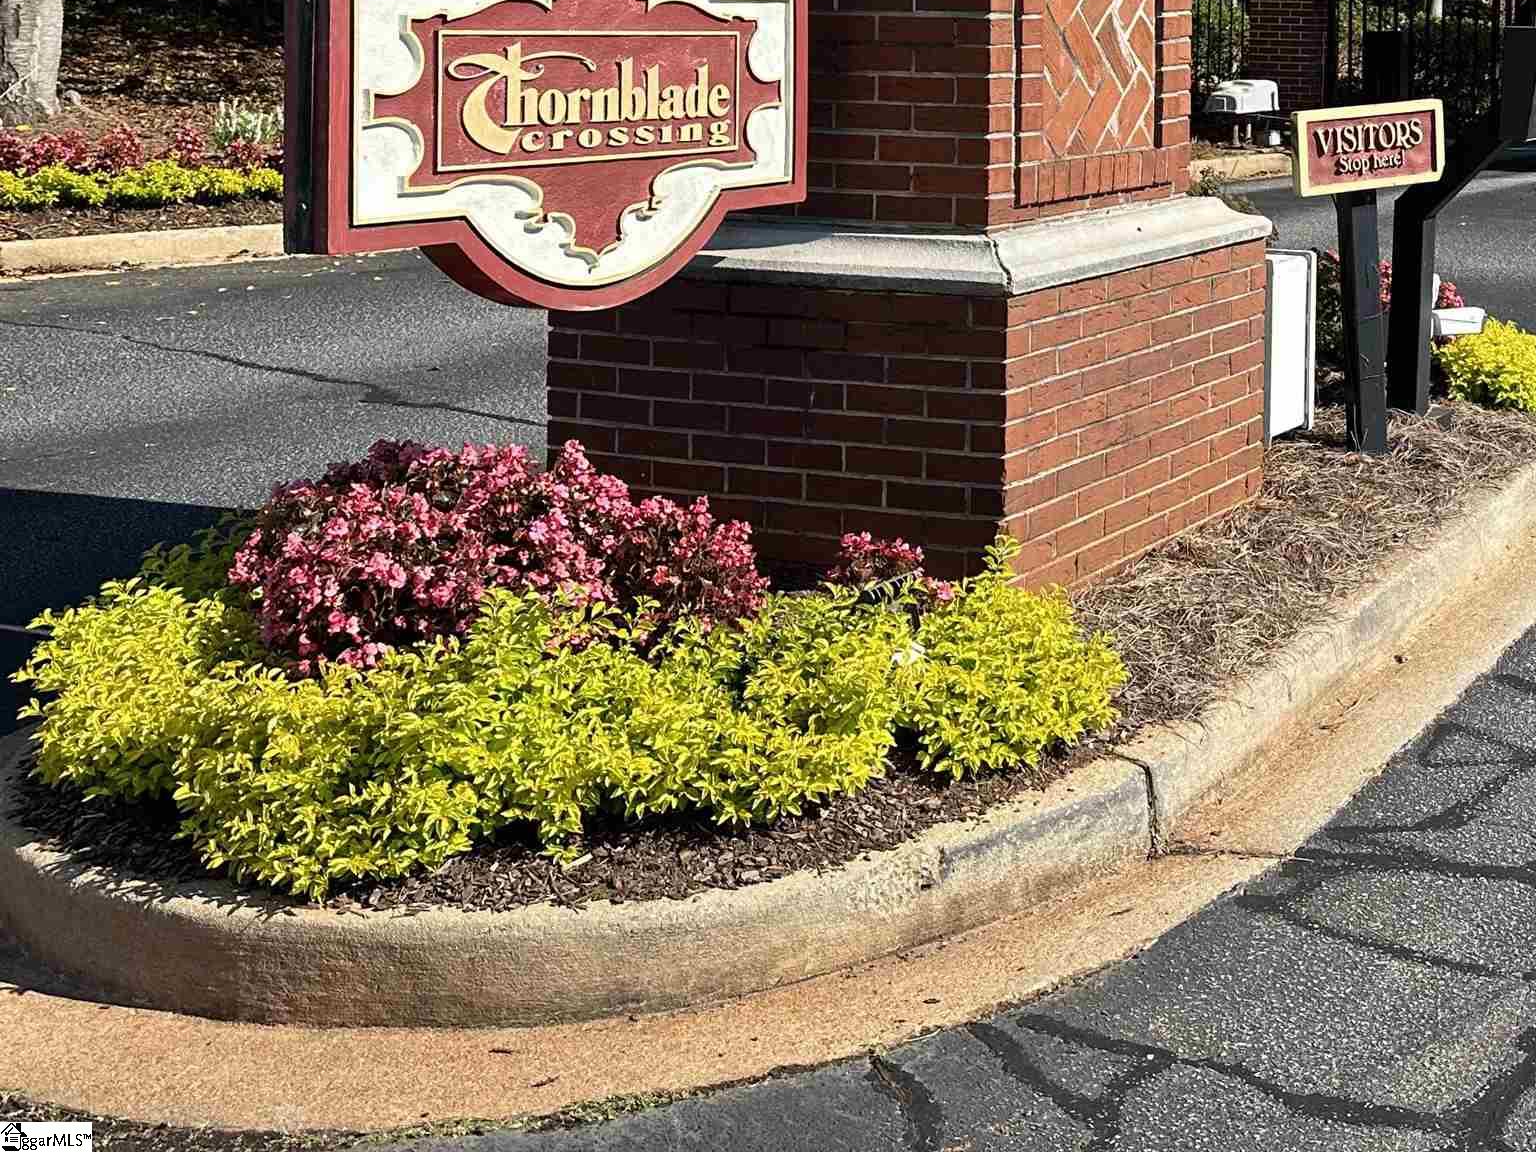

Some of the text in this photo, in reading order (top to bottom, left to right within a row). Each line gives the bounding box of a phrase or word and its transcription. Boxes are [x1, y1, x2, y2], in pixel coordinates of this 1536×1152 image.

[446, 41, 732, 154] Thornblade
[520, 119, 732, 153] crossing
[1314, 117, 1424, 156] VISITORS
[1337, 149, 1407, 175] Stop here!
